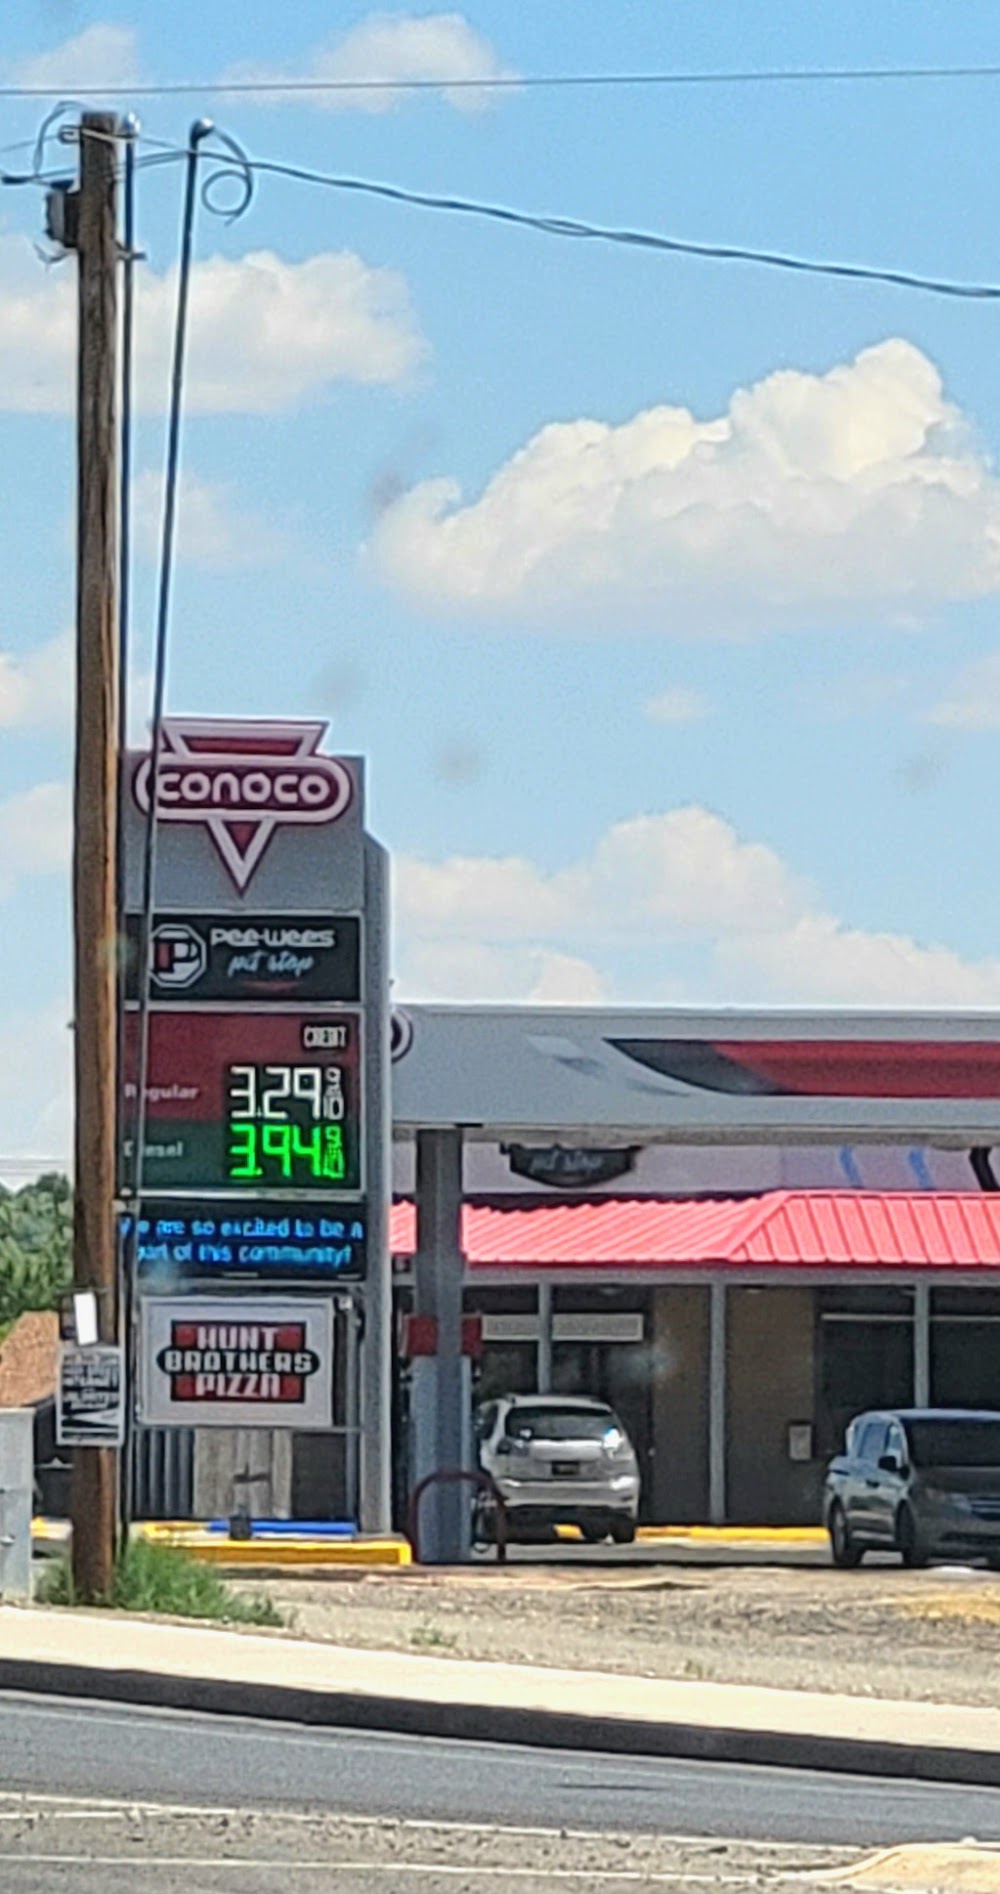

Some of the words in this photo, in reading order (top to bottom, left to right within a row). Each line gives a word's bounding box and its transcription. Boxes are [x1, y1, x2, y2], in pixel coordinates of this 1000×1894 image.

[192, 1220, 215, 1236] so
[197, 1326, 278, 1350] HUNT
[164, 1352, 313, 1373] BROTHERS
[195, 1374, 281, 1397] PIZZA
